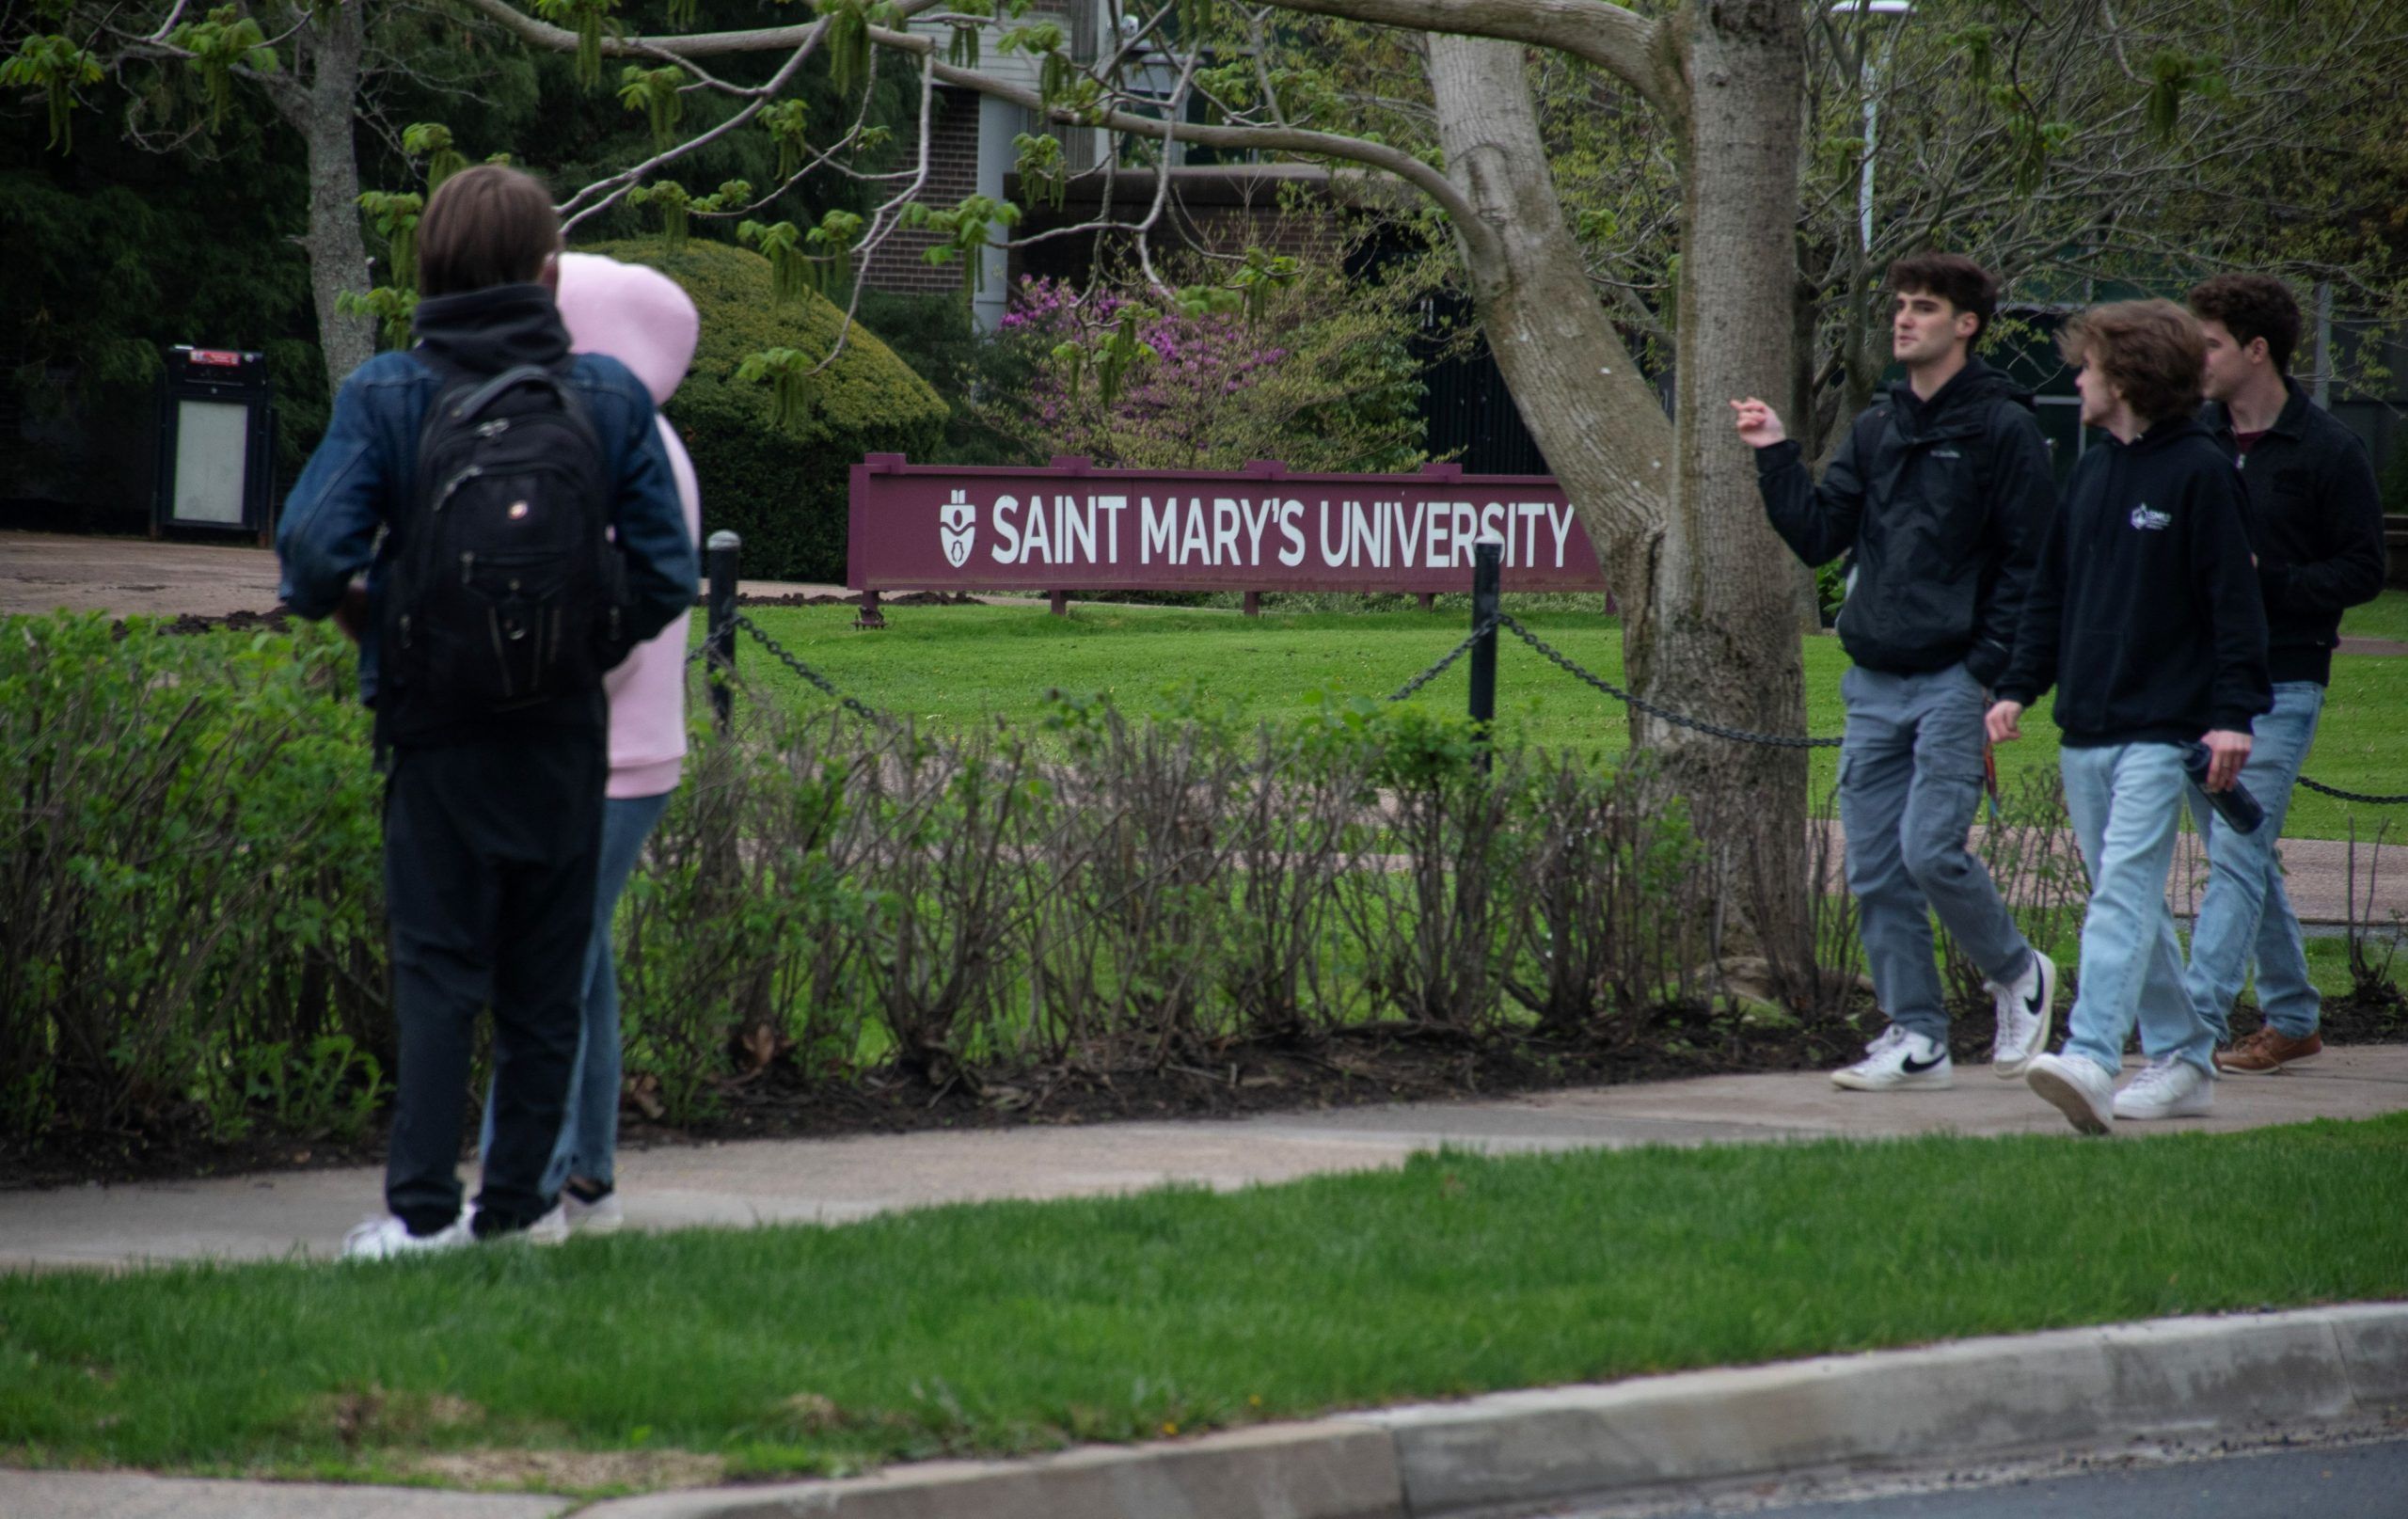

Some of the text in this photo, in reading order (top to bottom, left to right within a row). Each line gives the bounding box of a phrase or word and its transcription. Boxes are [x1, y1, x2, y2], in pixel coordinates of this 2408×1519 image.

[990, 494, 1576, 568] SAINT MARY'S UNIVERSITY
